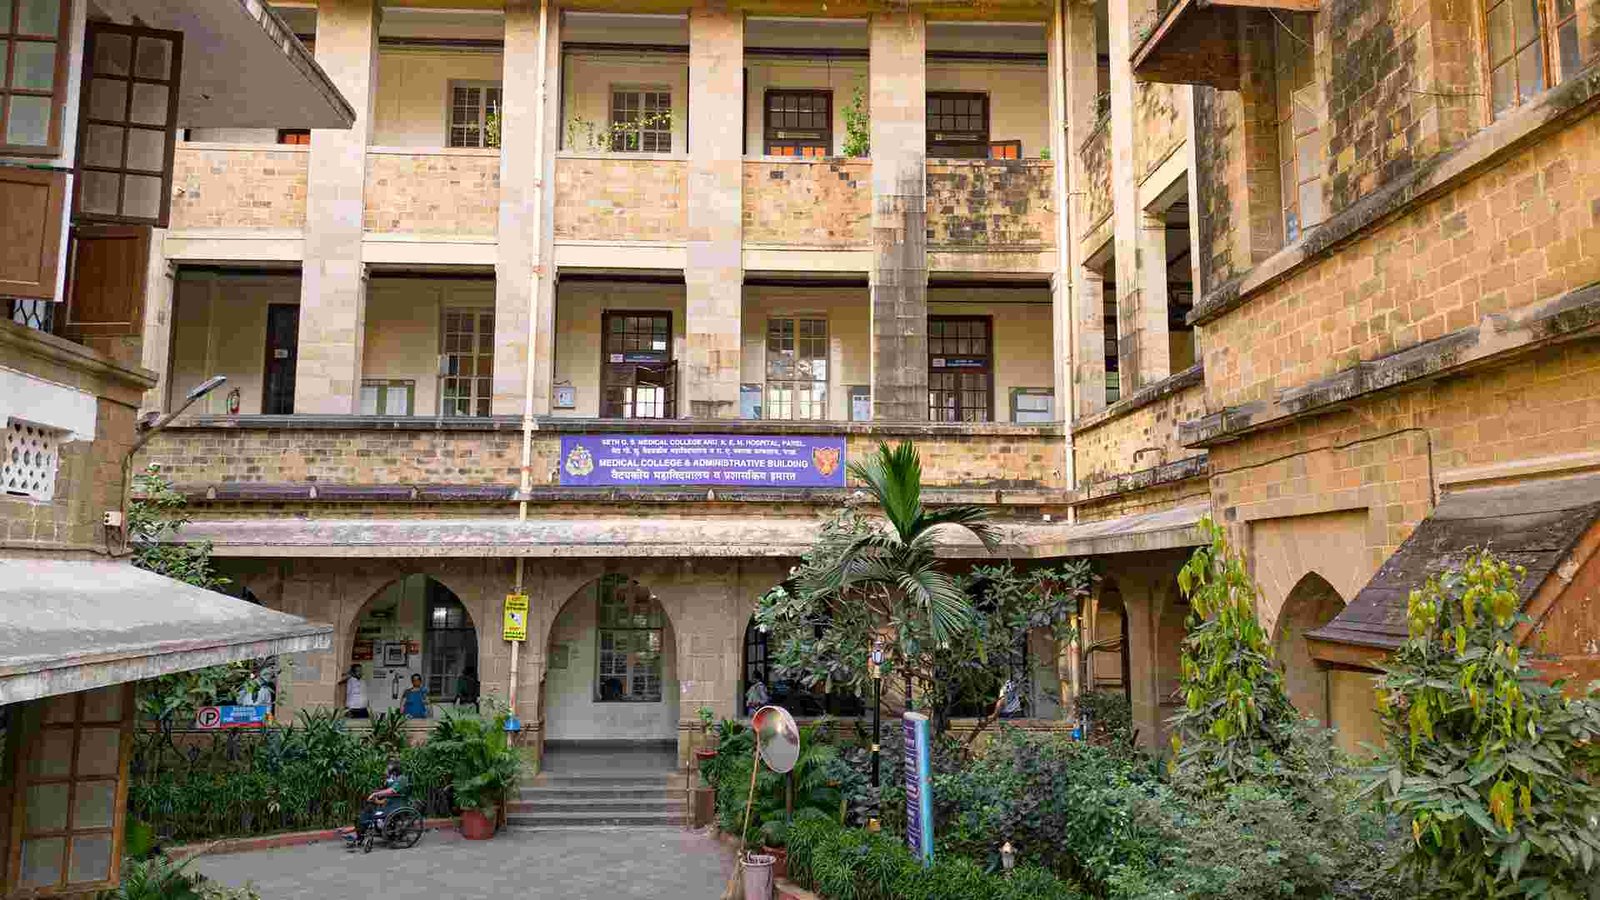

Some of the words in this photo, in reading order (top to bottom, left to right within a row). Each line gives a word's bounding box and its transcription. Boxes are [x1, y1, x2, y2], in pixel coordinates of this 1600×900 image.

[599, 459, 639, 467] MEDICAL
[641, 459, 683, 467] COLLEGE
[693, 459, 765, 468] ADMINISTRATIVE
[767, 459, 809, 468] BUILDING
